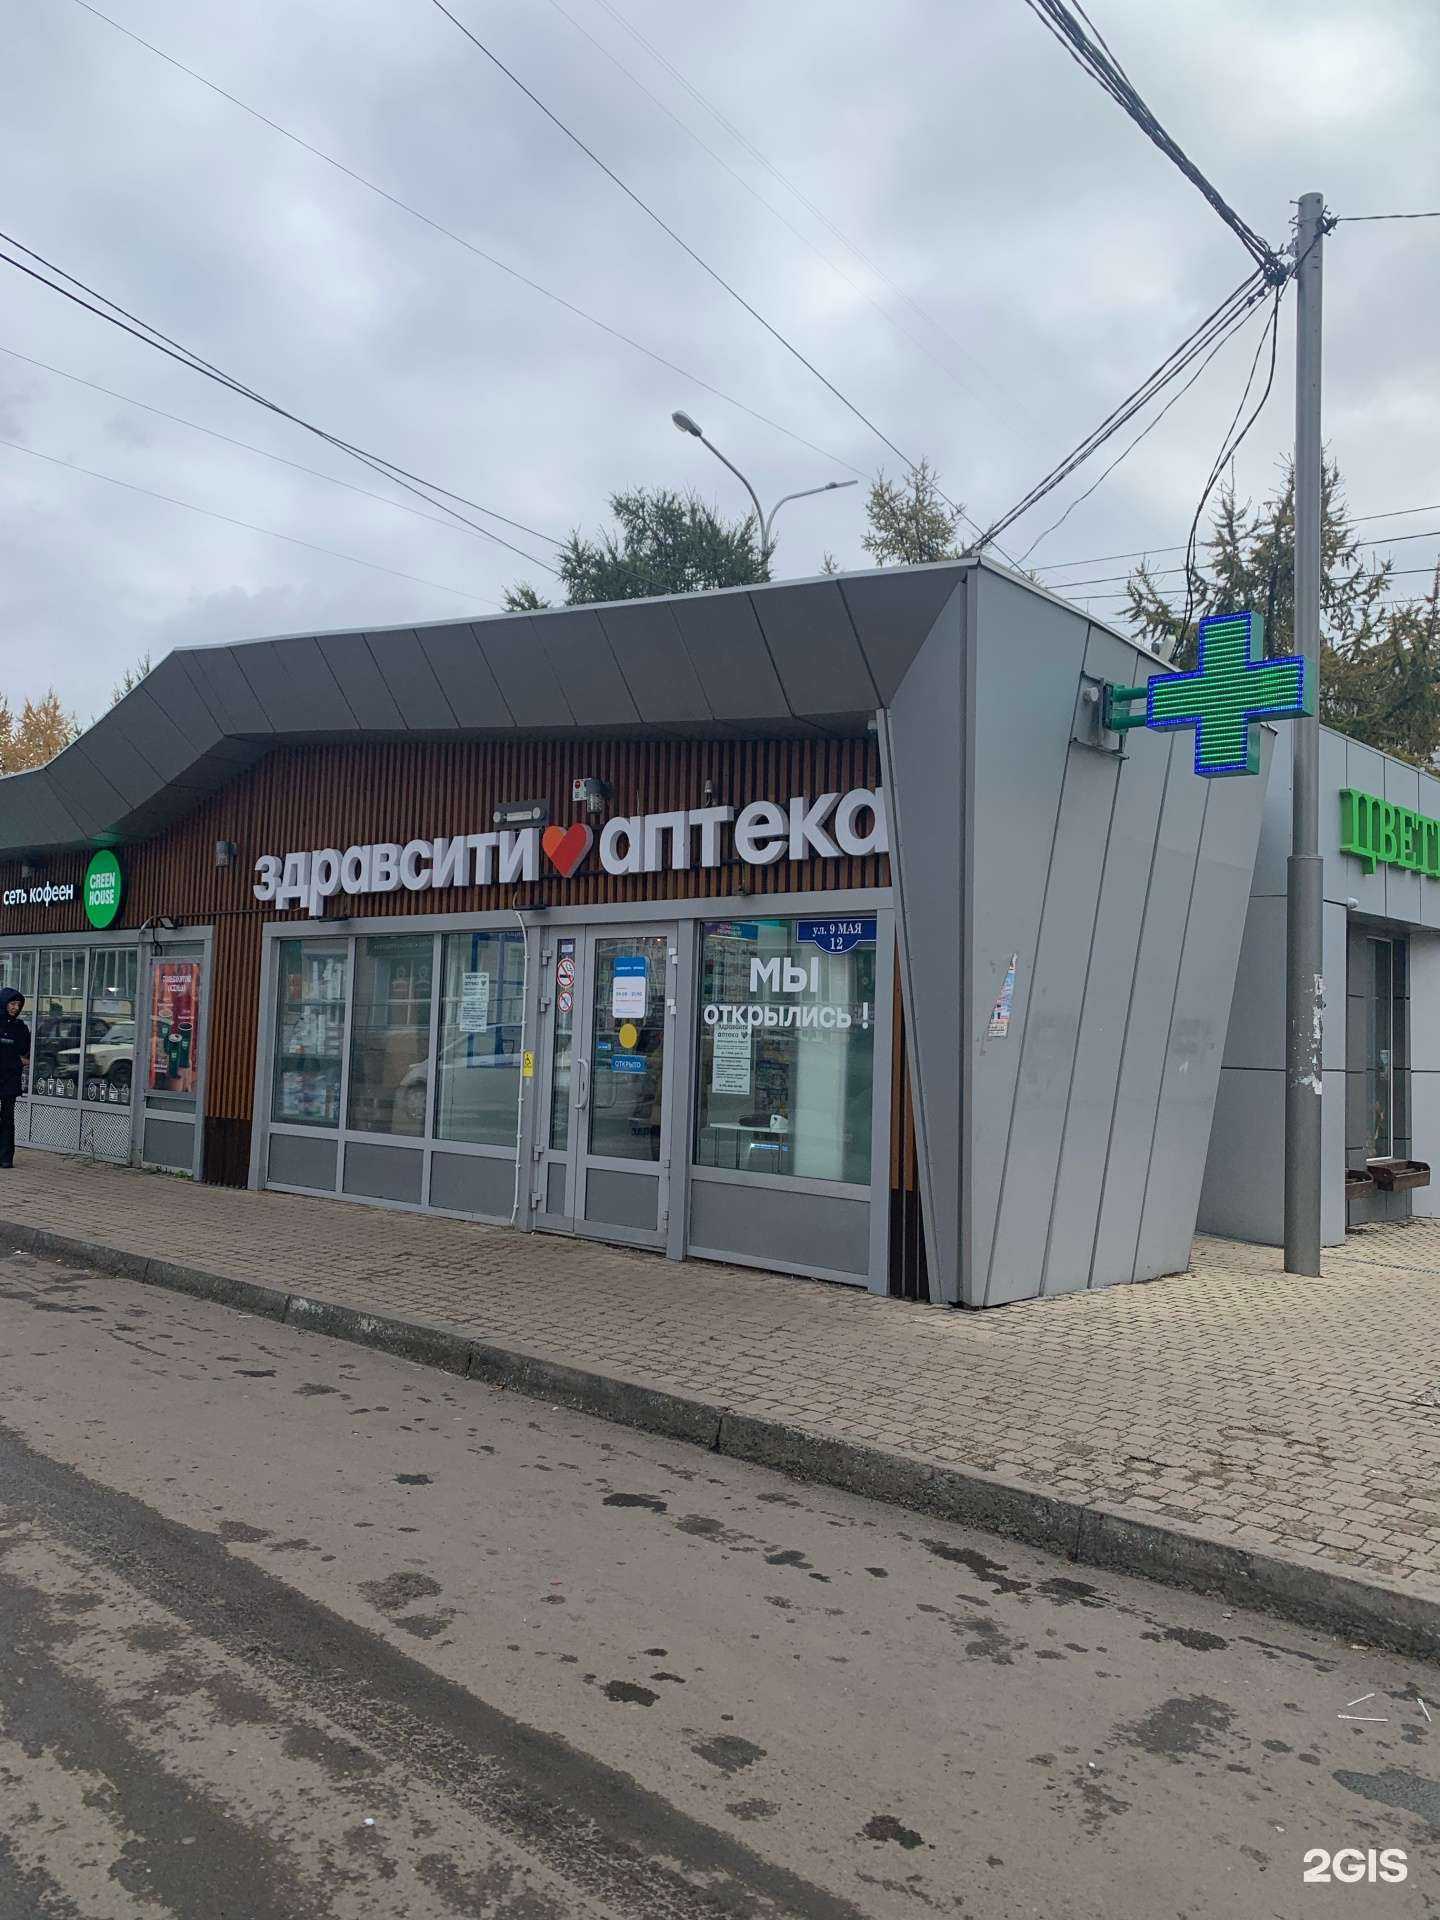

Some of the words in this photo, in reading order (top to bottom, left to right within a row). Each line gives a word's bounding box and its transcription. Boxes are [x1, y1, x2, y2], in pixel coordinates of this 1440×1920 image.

[600, 787, 889, 876] аптека
[1339, 787, 1440, 879] ЦВЕТ
[89, 872, 116, 889] GREEN
[3, 889, 27, 905] сеть
[30, 881, 74, 907] кофеен
[89, 889, 115, 906] HOUSE
[812, 926, 827, 937] ул.
[829, 923, 836, 935] 9
[838, 922, 862, 935] МАЯ
[830, 937, 843, 950] 12
